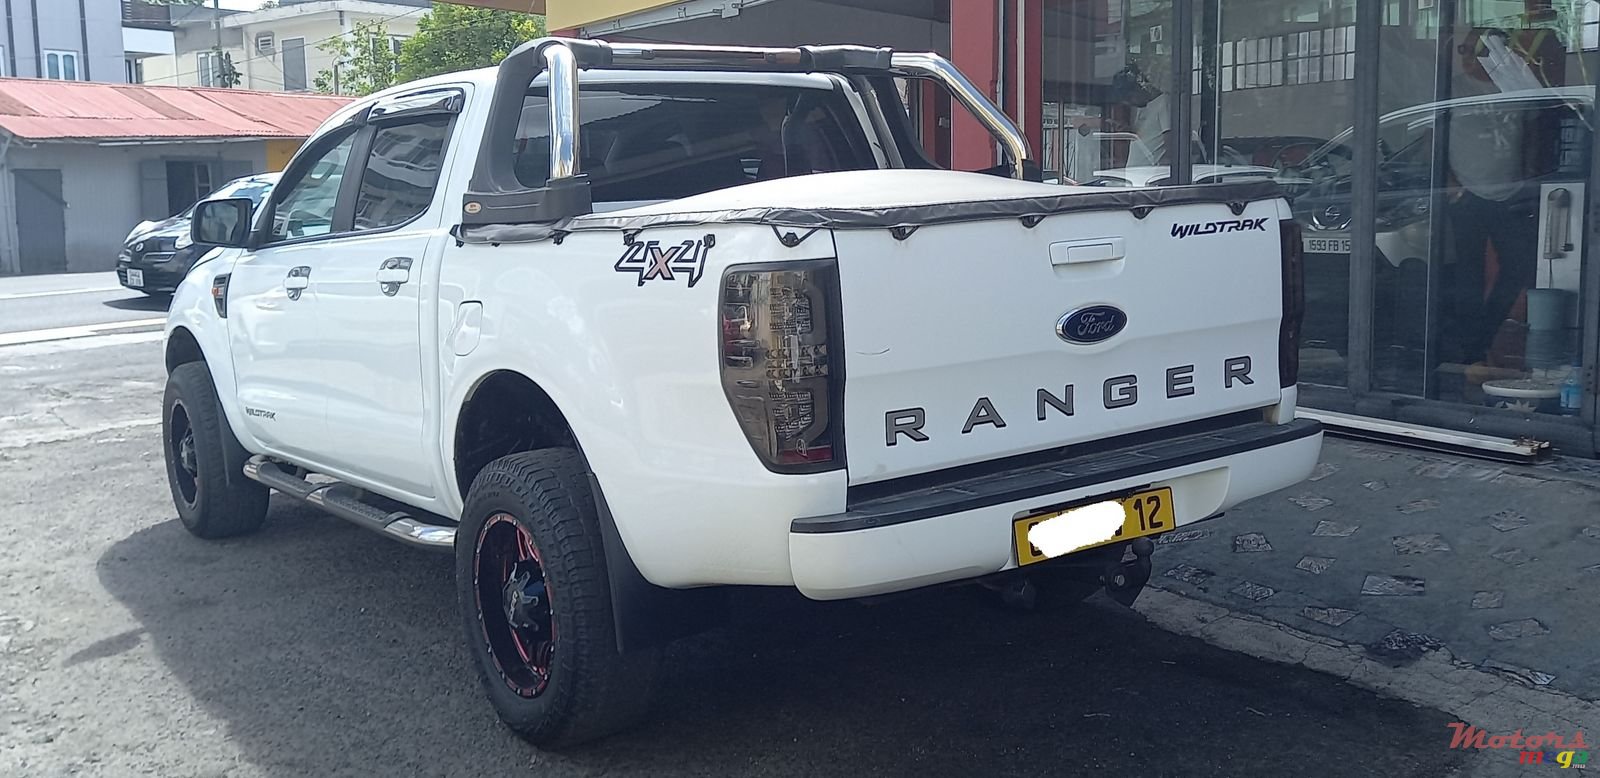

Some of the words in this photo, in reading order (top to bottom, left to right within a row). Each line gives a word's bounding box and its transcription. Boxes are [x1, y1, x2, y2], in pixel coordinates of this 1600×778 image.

[1171, 217, 1269, 239] WILDTRAK
[1077, 311, 1115, 336] Ford
[885, 355, 1254, 446] RANGER
[1133, 495, 1163, 531] 12
